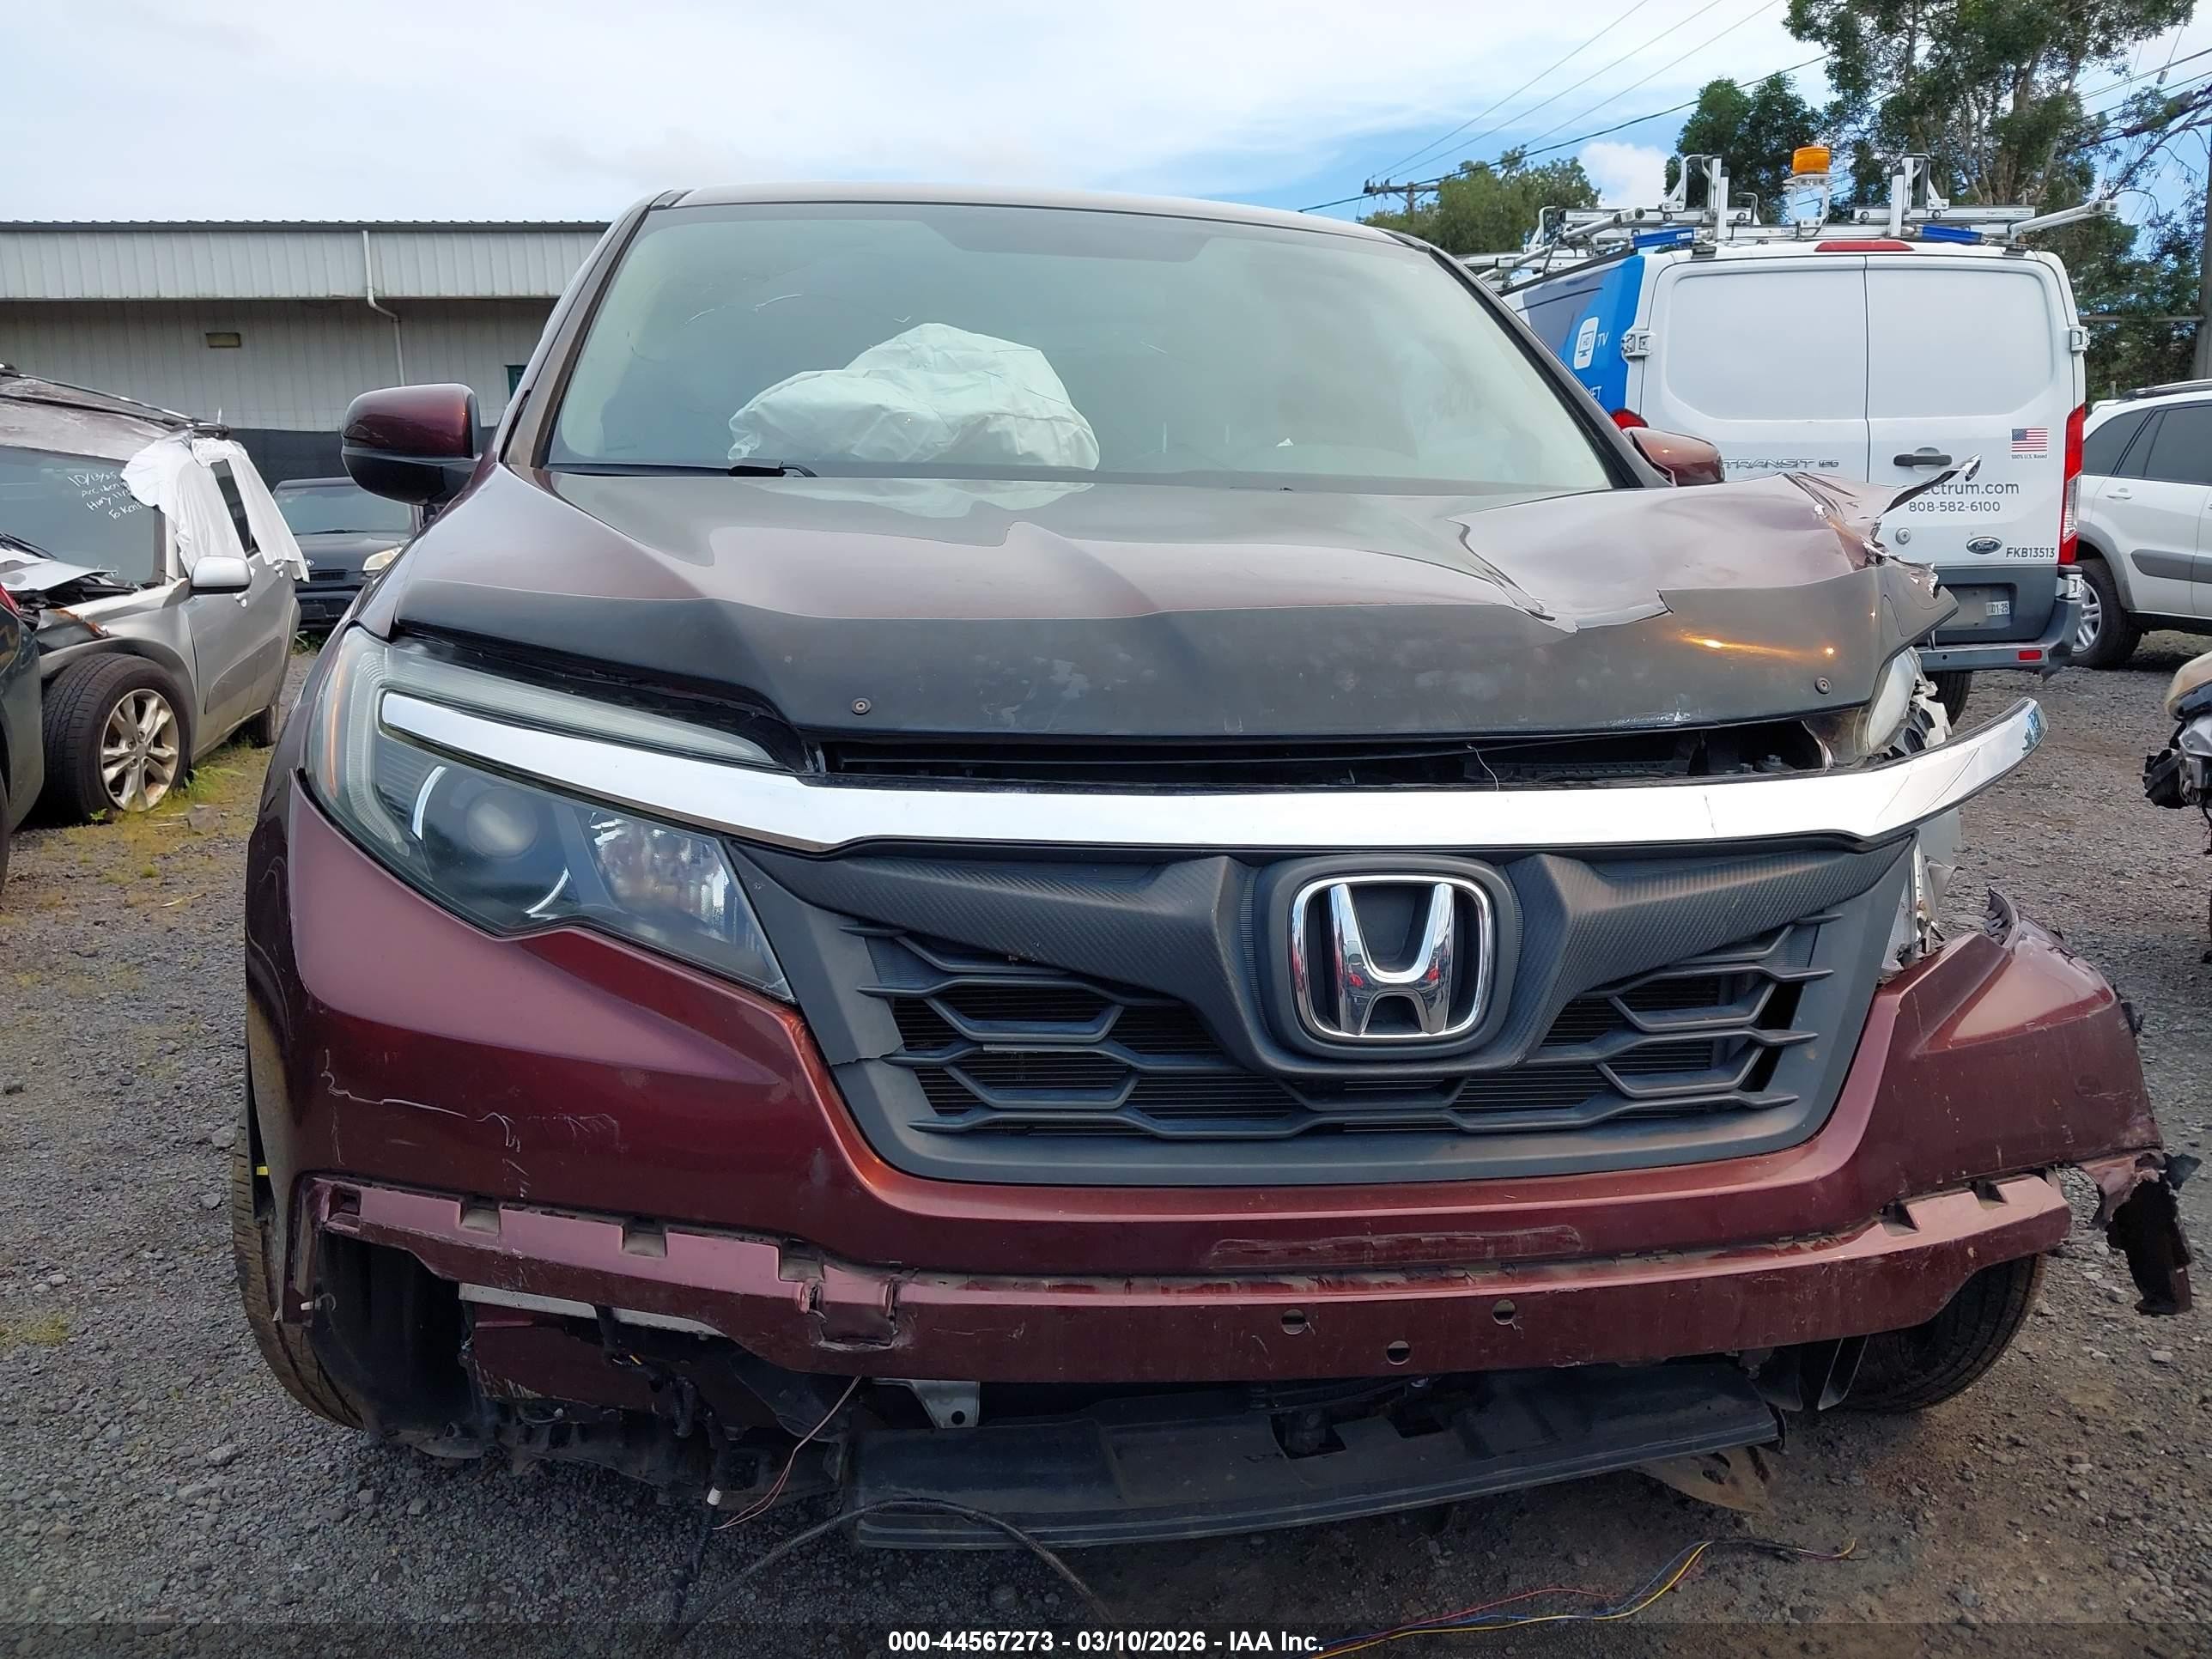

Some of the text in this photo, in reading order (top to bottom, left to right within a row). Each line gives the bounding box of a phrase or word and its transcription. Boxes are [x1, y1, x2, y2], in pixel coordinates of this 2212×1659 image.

[1597, 331, 1609, 347] TV
[1723, 459, 1814, 469] TRANSIT
[86, 495, 112, 511] Hwy
[1909, 501, 2001, 512] 808-582-6100
[108, 508, 121, 520] To
[2006, 547, 2055, 558] FKB13513
